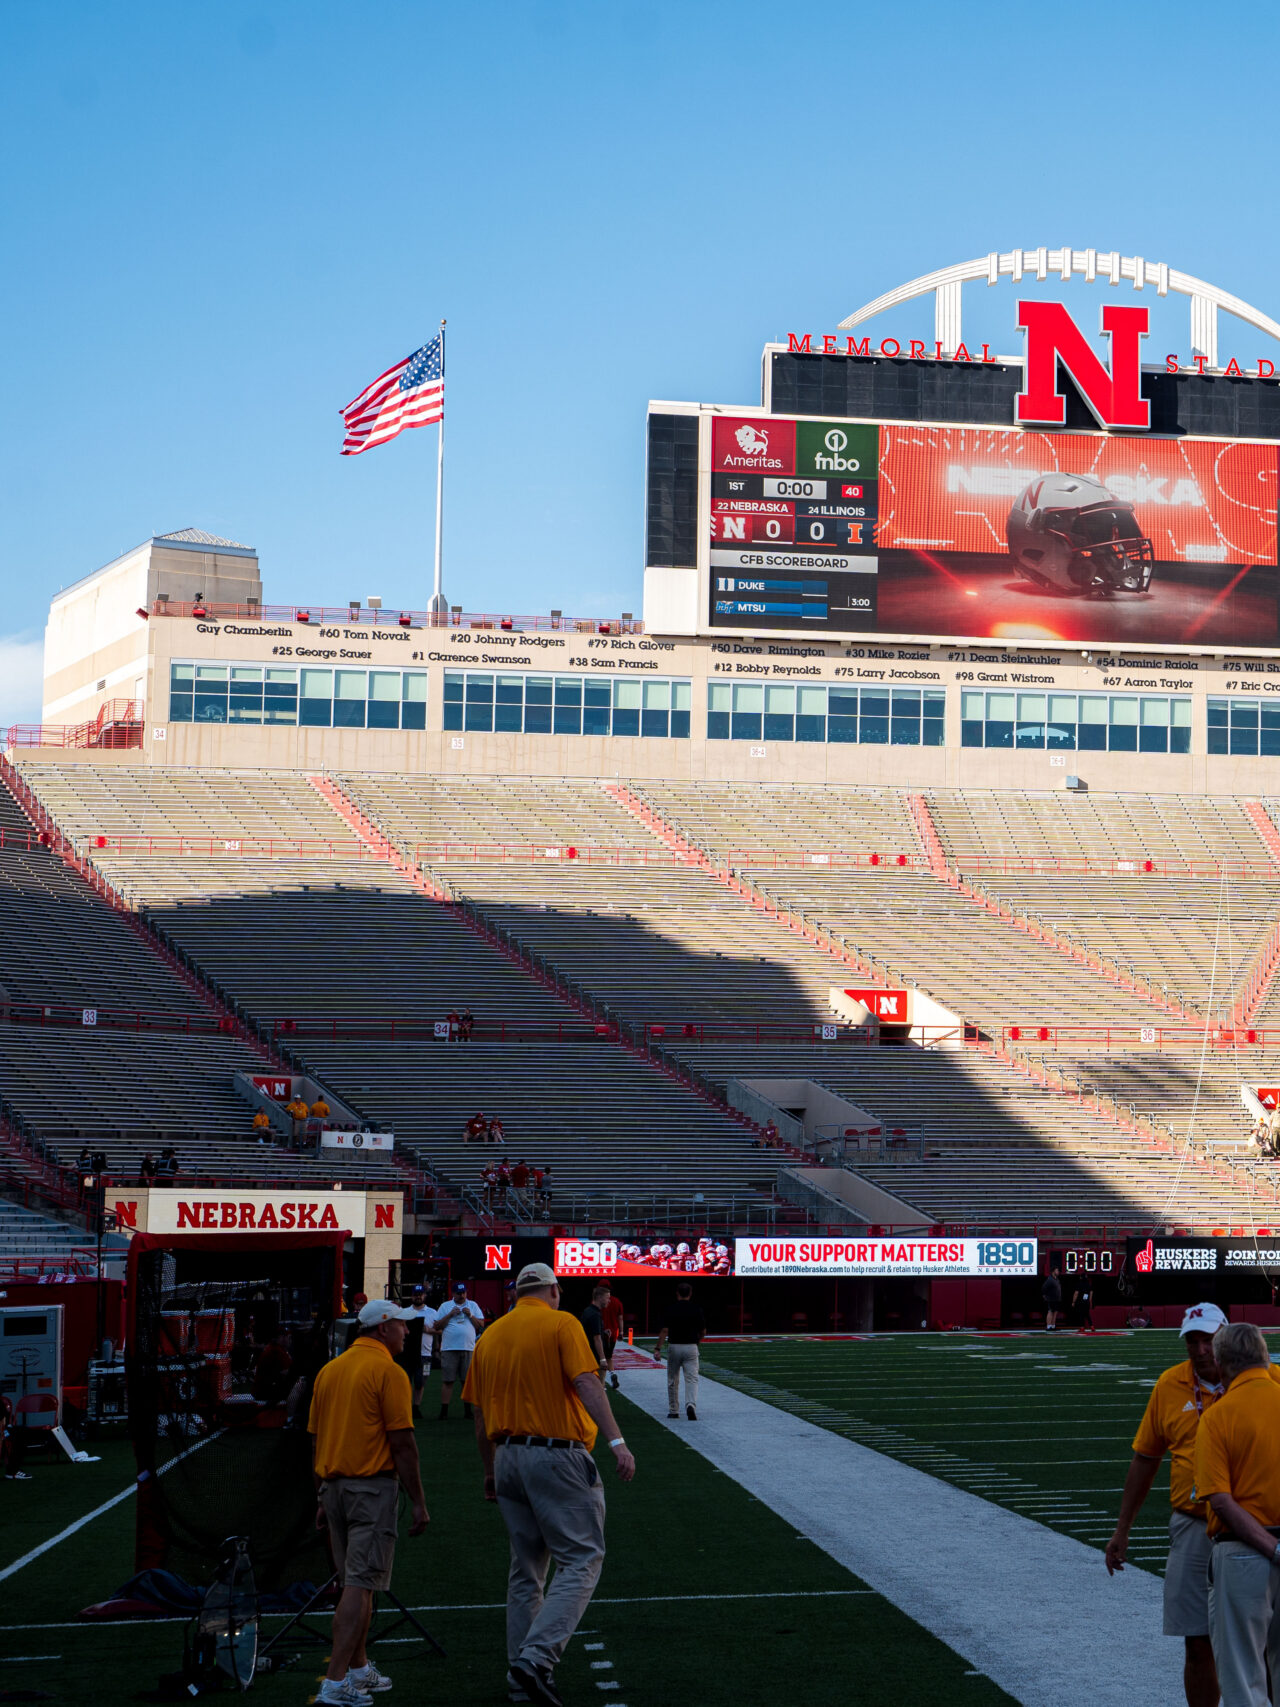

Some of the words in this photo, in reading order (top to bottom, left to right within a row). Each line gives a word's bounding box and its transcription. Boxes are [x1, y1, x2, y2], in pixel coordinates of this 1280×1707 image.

[787, 332, 996, 363] MEMORIAL
[1013, 300, 1151, 430] N
[815, 452, 860, 471] fnbo
[728, 482, 744, 490] 1ST
[777, 482, 813, 496] 0:00
[846, 487, 859, 496] 40
[718, 502, 728, 510] 22
[730, 501, 788, 513] NEBRASKA
[808, 506, 819, 514] 24
[820, 506, 865, 516] ILLINOIS
[723, 517, 745, 539] N
[766, 520, 780, 538] 0
[810, 522, 824, 540] 0
[740, 554, 763, 565] CFB
[766, 556, 848, 568] SCOREBOARD
[738, 582, 765, 590] DUKE
[738, 604, 766, 612] MTSU
[852, 598, 870, 606] 3:00
[196, 624, 222, 636] Guy
[224, 626, 292, 637] Chamberlin
[320, 628, 340, 638] #60
[343, 630, 368, 640] Tom
[372, 630, 410, 641] Novak
[450, 634, 471, 644] #20
[474, 634, 516, 648] Johnny
[520, 636, 566, 648] Rodgers
[588, 639, 608, 648] #79
[610, 640, 635, 650] Rich
[638, 640, 676, 651] Glover
[711, 643, 731, 653] #50
[734, 644, 762, 654] Dave
[768, 645, 826, 658] Rimington
[412, 651, 424, 661] #1
[428, 652, 479, 662] Clarence
[482, 654, 532, 665] Swanson
[948, 652, 966, 662] #71
[970, 652, 999, 663] Dean
[1001, 653, 1062, 666] Steinkuhler
[1096, 657, 1116, 667] #54
[1118, 658, 1162, 669] Dominic
[1164, 659, 1198, 670] Raiola
[834, 667, 854, 676] #75
[856, 668, 886, 680] Larry
[888, 668, 940, 680] Jacobson
[1222, 662, 1242, 672] #75
[1244, 662, 1264, 672] Will
[1226, 680, 1238, 690] #7
[1240, 681, 1262, 691] Eric
[156, 730, 164, 739] 34
[880, 997, 898, 1014] N
[84, 1010, 95, 1023] 33
[435, 1024, 448, 1034] 34
[824, 1026, 835, 1038] 35
[1142, 1030, 1152, 1040] 36
[176, 1202, 339, 1229] NEBRASKA
[375, 1204, 394, 1228] N
[485, 1244, 512, 1270] N
[556, 1242, 617, 1267] 1890
[748, 1244, 796, 1262] YOUR
[799, 1244, 878, 1262] SUPPORT
[881, 1244, 964, 1262] MATTERS!
[976, 1242, 1034, 1266] 1890
[1155, 1248, 1216, 1260] HUSKERS
[1225, 1250, 1256, 1260] JOIN
[741, 1265, 773, 1274] Contribute
[774, 1265, 780, 1274] at
[782, 1265, 843, 1274] 1890Nebraska.com
[844, 1265, 850, 1274] to
[852, 1265, 864, 1275] help
[866, 1265, 886, 1274] recruit
[887, 1265, 892, 1274] &
[893, 1265, 911, 1274] retain
[912, 1265, 922, 1275] top
[922, 1265, 944, 1274] Husker
[944, 1265, 970, 1274] Athletes
[1155, 1260, 1216, 1270] REWARDS
